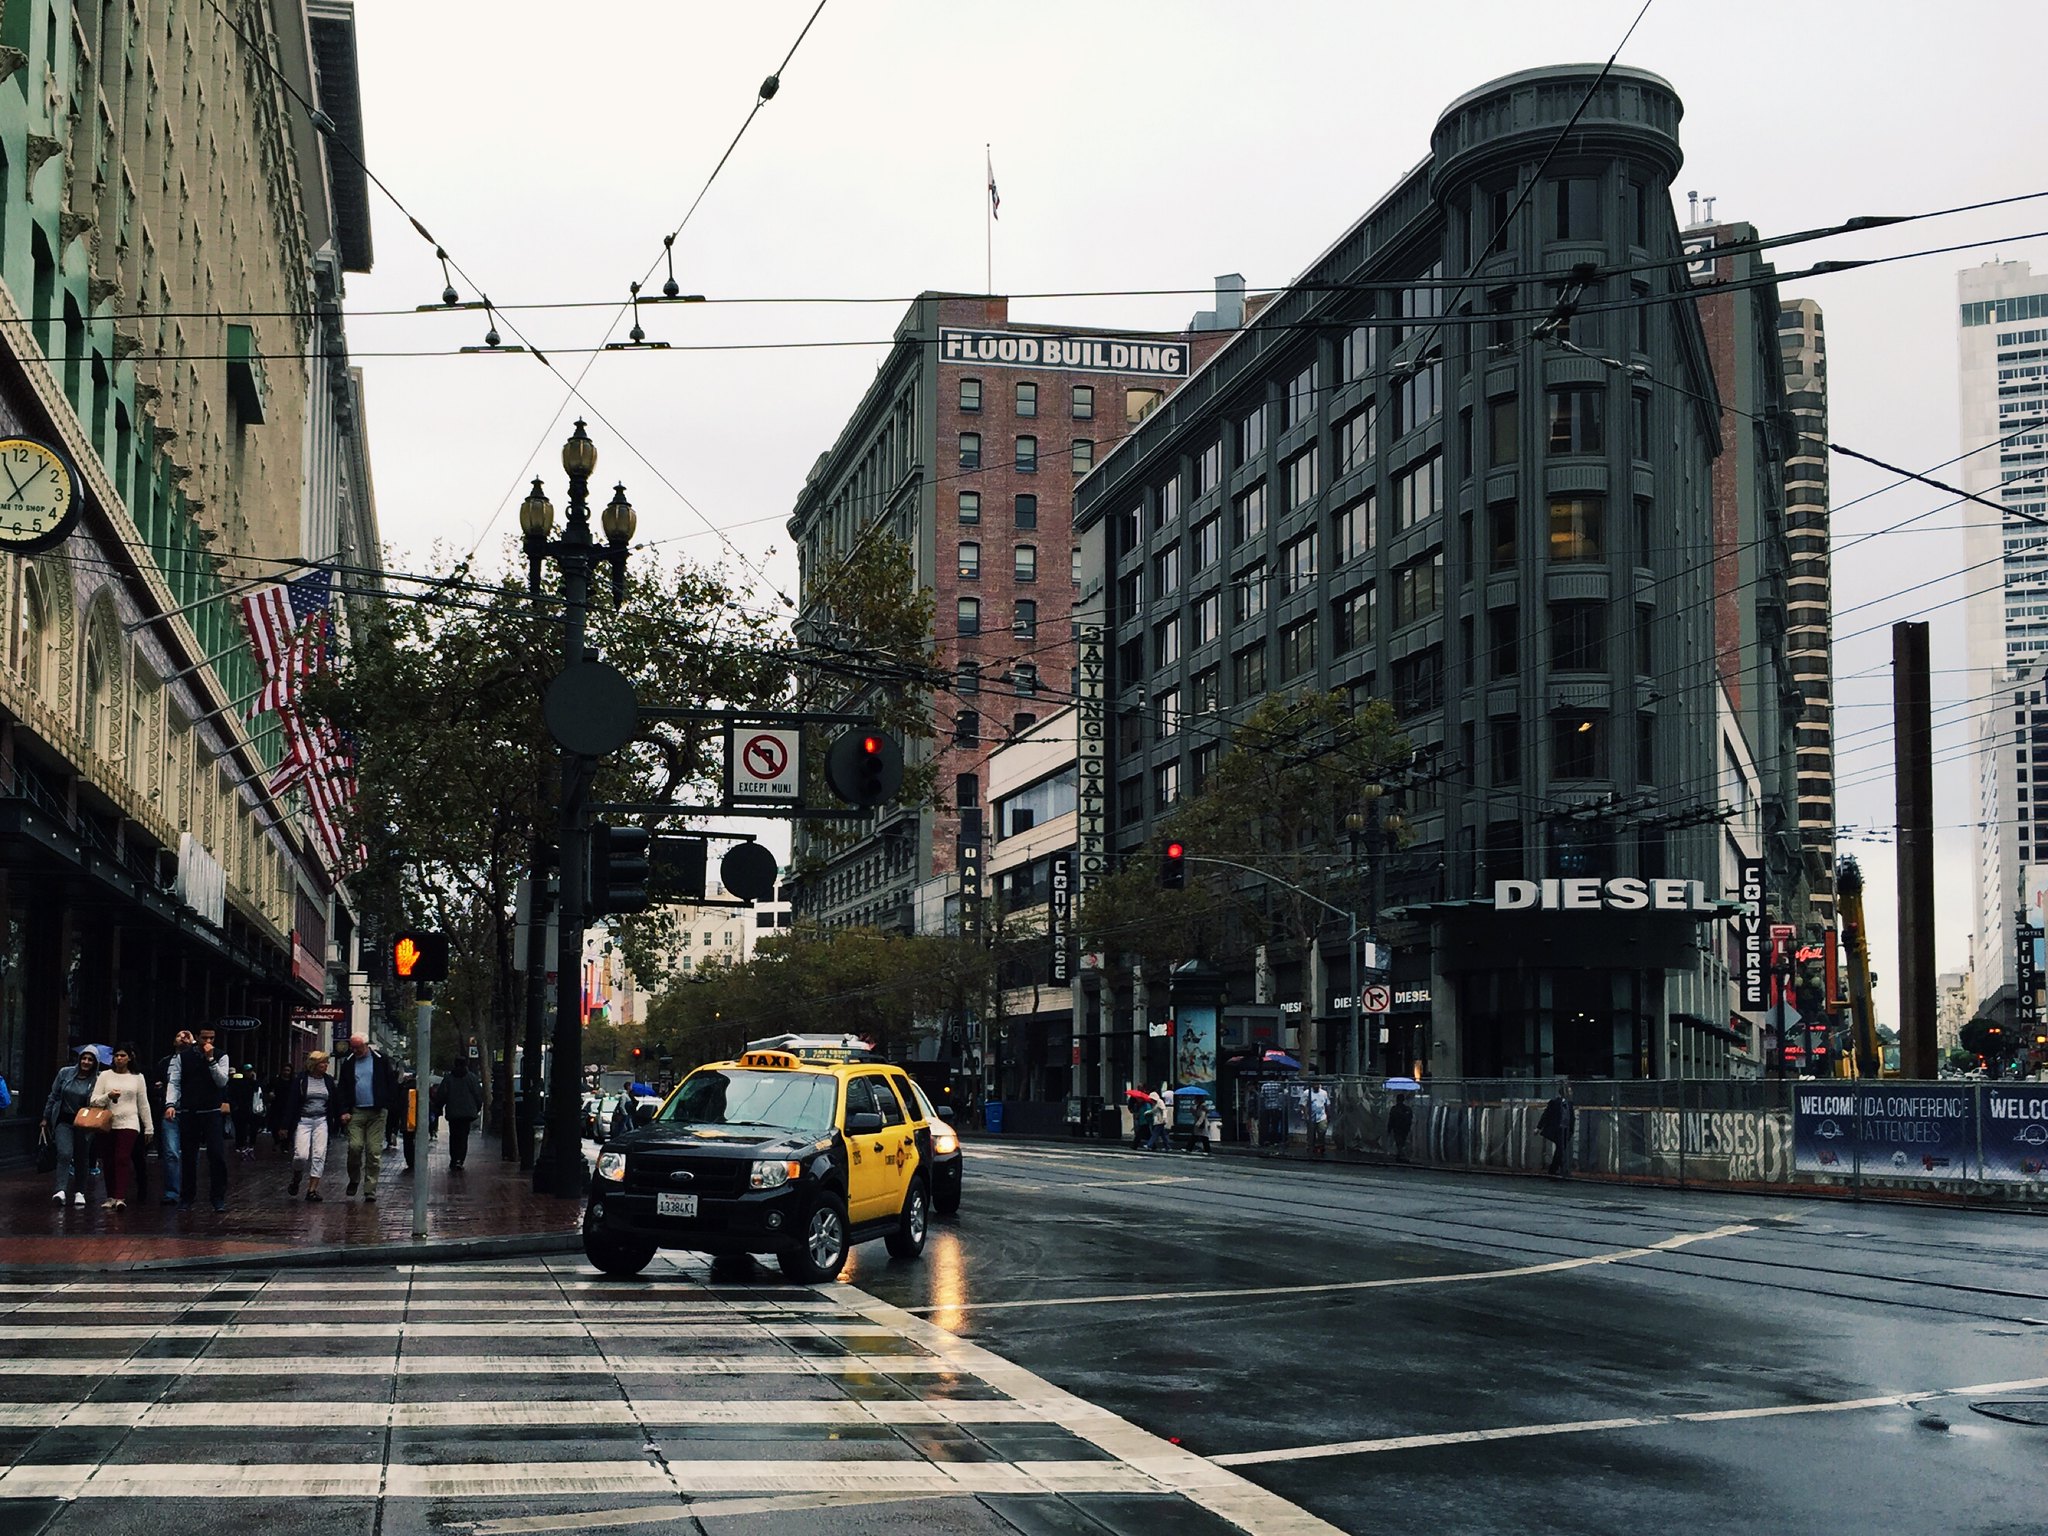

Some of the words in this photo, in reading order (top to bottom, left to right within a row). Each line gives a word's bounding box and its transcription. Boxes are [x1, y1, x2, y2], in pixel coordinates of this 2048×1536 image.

[947, 333, 1038, 363] FLOOD
[1043, 340, 1180, 372] BUILDING
[13, 448, 28, 462] 12
[50, 469, 59, 483] 2
[54, 488, 63, 501] 3
[48, 507, 57, 520] 4
[12, 522, 21, 535] 6
[33, 519, 41, 532] 5
[739, 782, 767, 792] EXCEPT
[772, 783, 791, 793] MUNI
[964, 848, 976, 943] OAKLE
[1494, 877, 1718, 911] DIESEL
[1054, 860, 1067, 979] CONVERSE
[1743, 867, 1761, 1002] CONVERSE
[2021, 941, 2033, 1018] FUSION
[1395, 990, 1432, 1004] DIESEL
[220, 1019, 234, 1027] OLD
[236, 1018, 256, 1027] NAVY
[745, 1054, 790, 1067] TAXI
[1864, 1097, 1885, 1117] IDA
[1887, 1098, 1969, 1118] CONFERENCE
[1651, 1112, 1757, 1155] BUSINESSES
[1864, 1121, 1941, 1143] ATTENDEES
[1728, 1155, 1756, 1182] ARE
